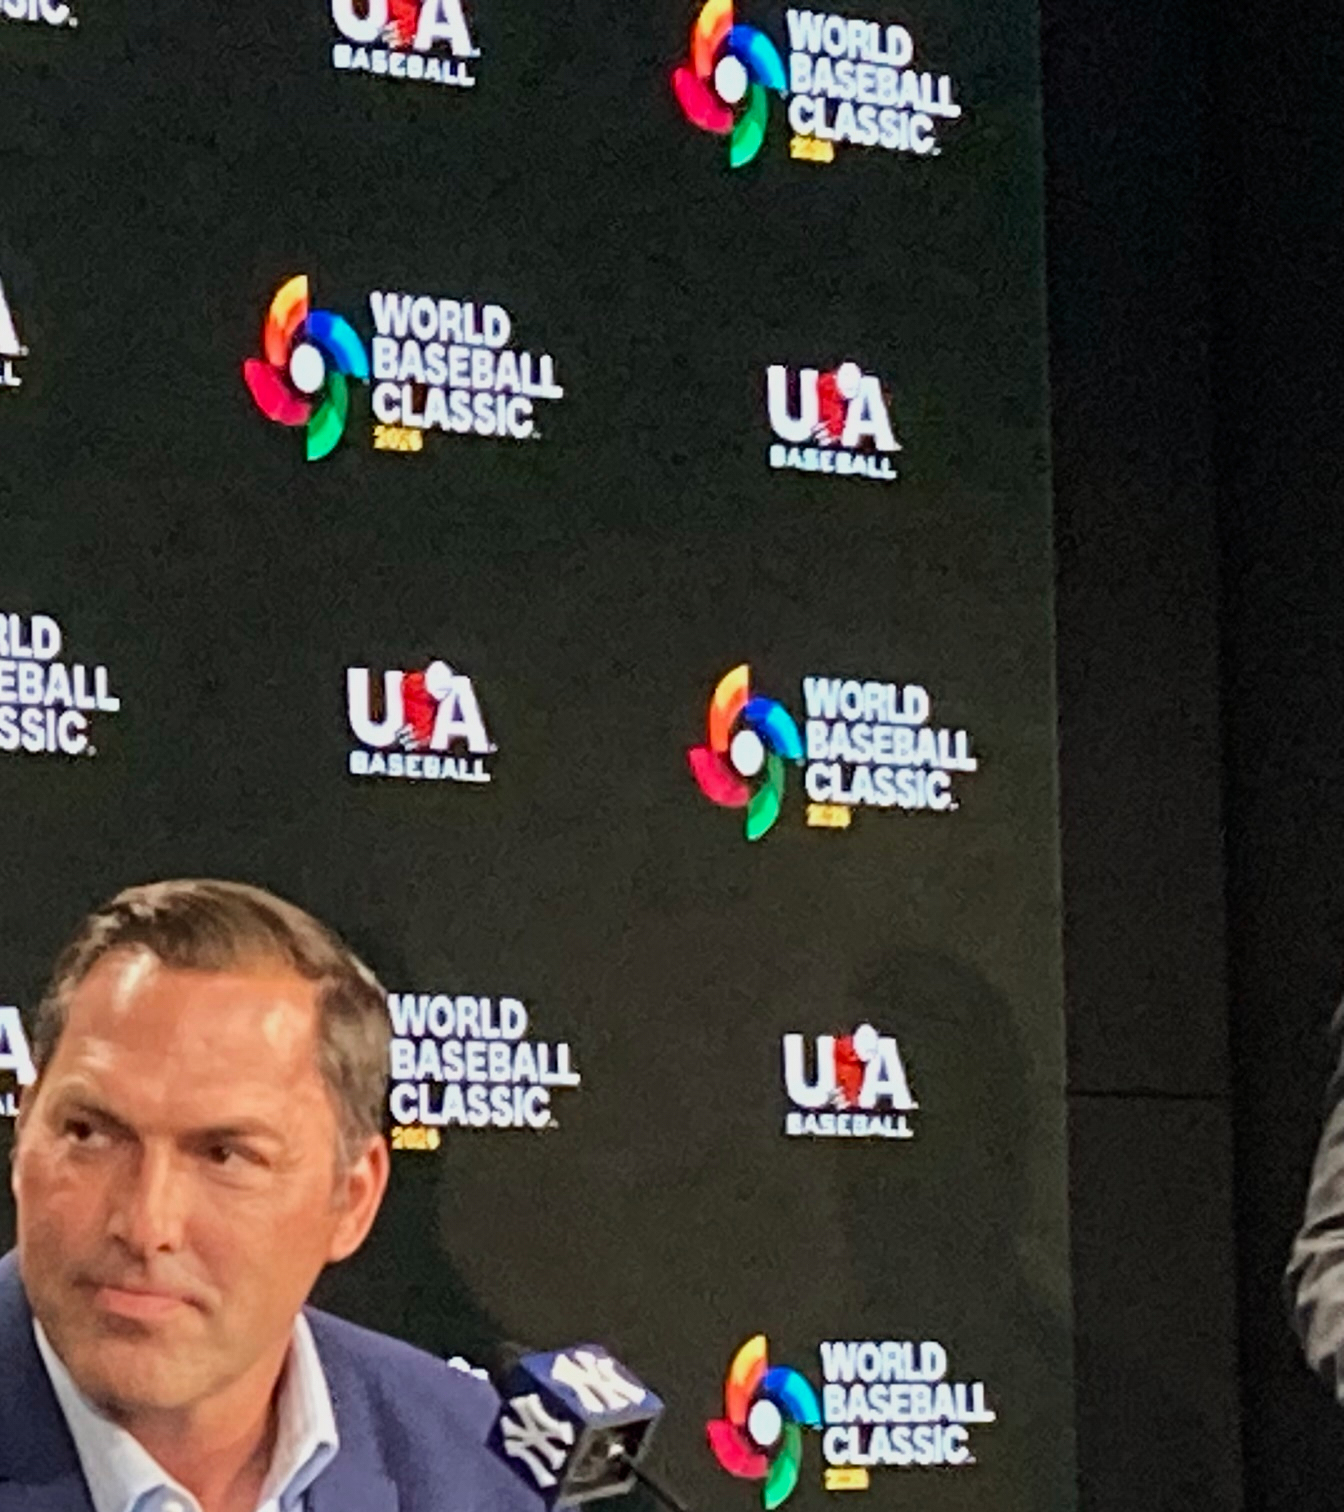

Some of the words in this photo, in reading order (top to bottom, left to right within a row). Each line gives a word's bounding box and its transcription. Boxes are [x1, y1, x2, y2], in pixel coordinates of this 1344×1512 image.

[787, 8, 913, 67] WORLD
[790, 52, 961, 118] BASEBALL
[788, 95, 934, 154] CLASSIC
[369, 291, 511, 349] WORLD
[372, 337, 563, 399] BASEBALL
[372, 382, 534, 439] CLASSIC
[803, 677, 929, 725] WORLD
[806, 719, 977, 772] BASEBALL
[805, 762, 952, 810] CLASSIC
[387, 993, 528, 1040] WORLD
[389, 1038, 581, 1086] BASEBALL
[389, 1082, 552, 1129] CLASSIC
[820, 1341, 947, 1382] WORLD
[823, 1381, 997, 1423] BASEBALL
[823, 1424, 971, 1465] CLASSIC
